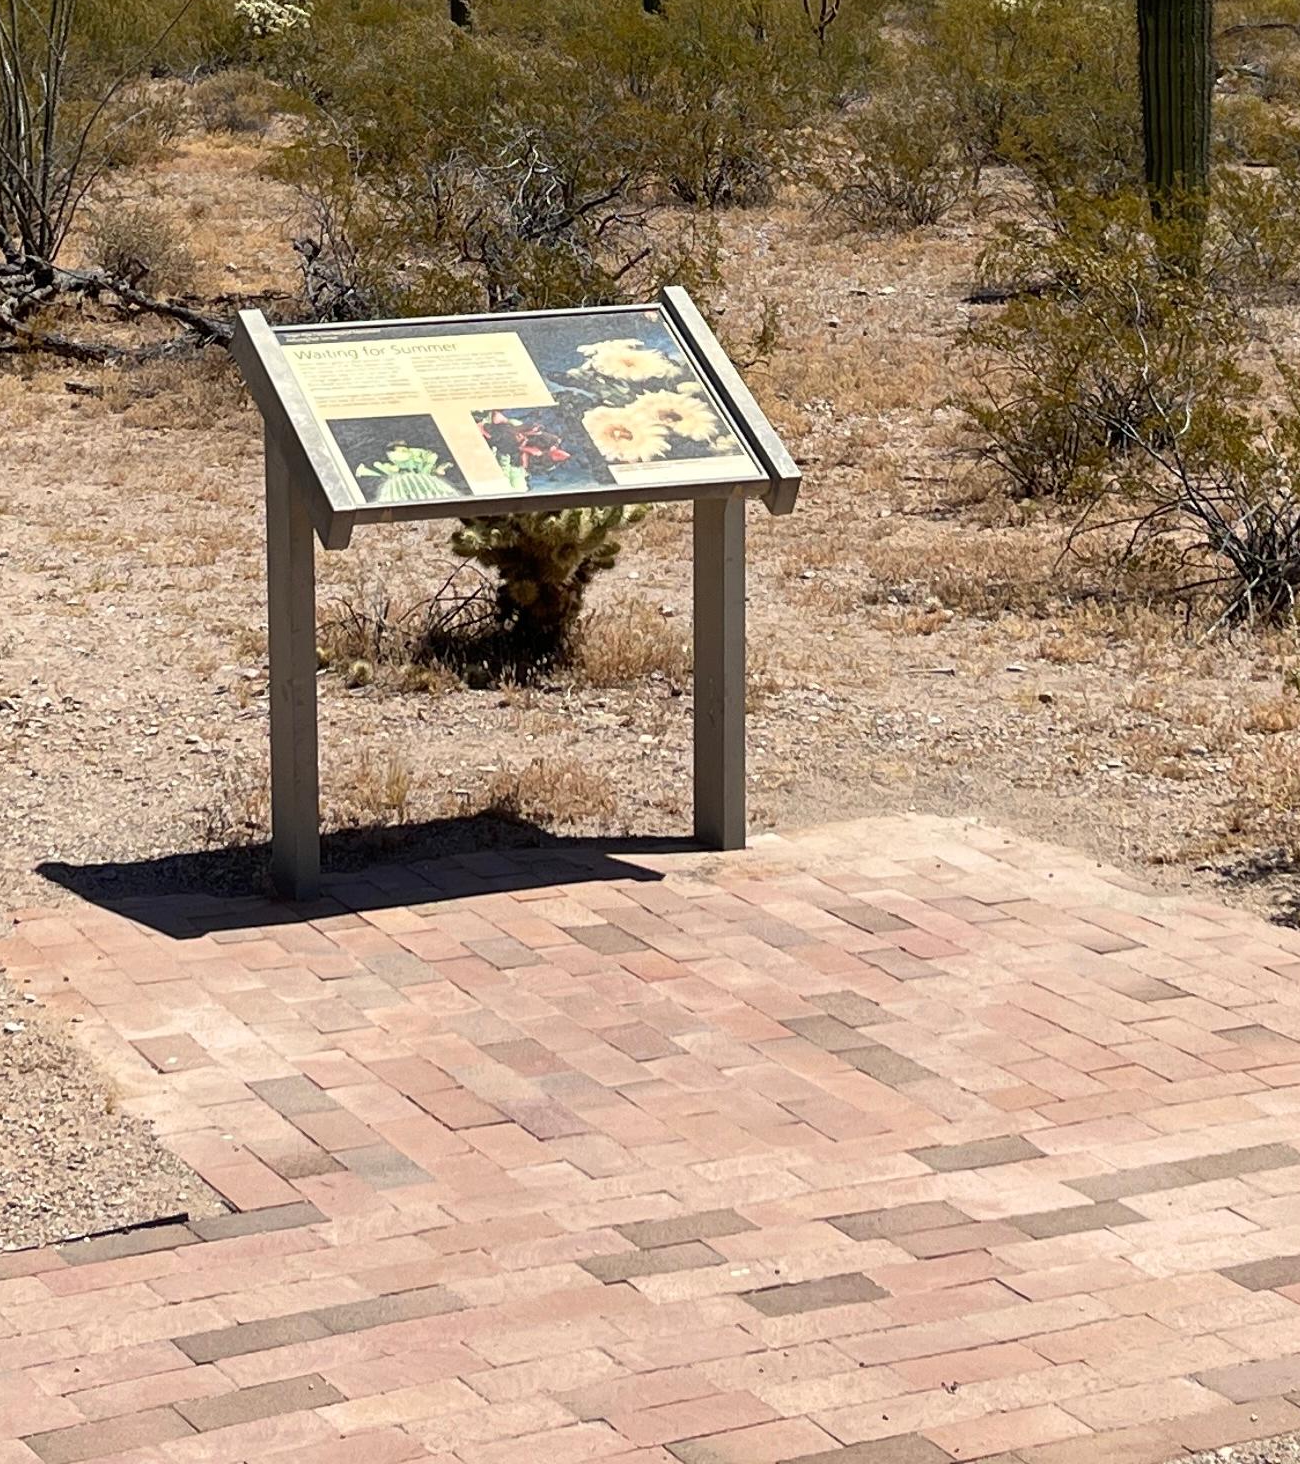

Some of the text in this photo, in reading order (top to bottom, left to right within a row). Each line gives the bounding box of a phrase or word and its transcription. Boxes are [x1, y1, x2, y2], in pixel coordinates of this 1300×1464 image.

[293, 342, 458, 360] Waiting for Summer
